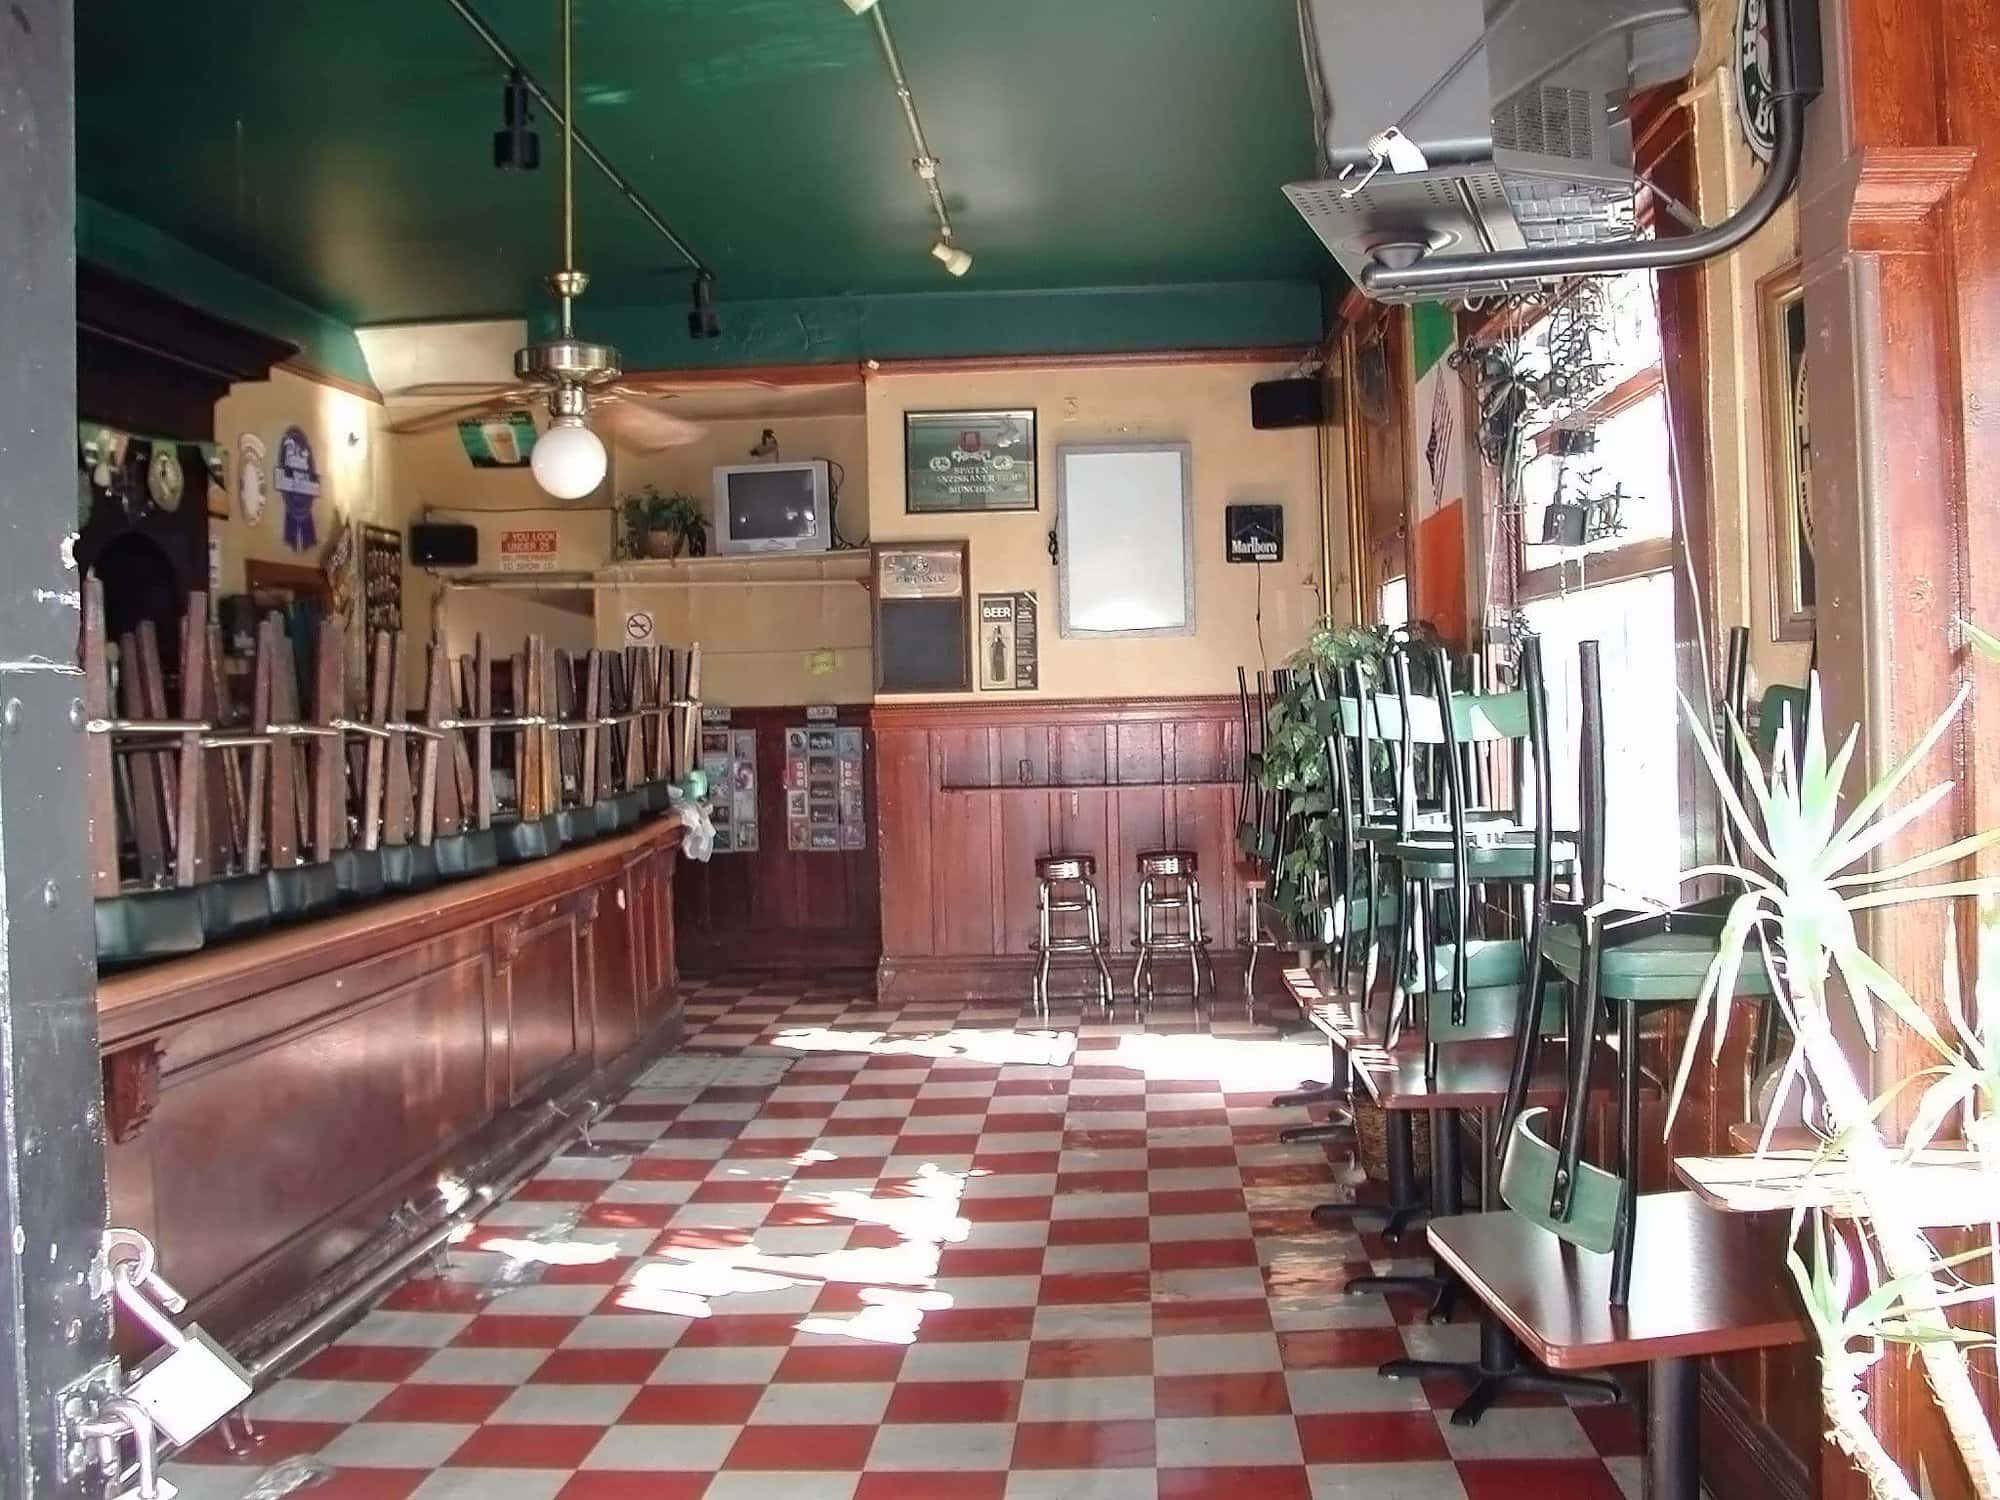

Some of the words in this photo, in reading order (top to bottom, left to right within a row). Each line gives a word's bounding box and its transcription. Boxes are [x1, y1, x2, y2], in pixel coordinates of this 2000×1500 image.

[513, 533, 529, 541] YOU
[1231, 536, 1277, 554] Marlboro
[983, 607, 1011, 618] BEER
